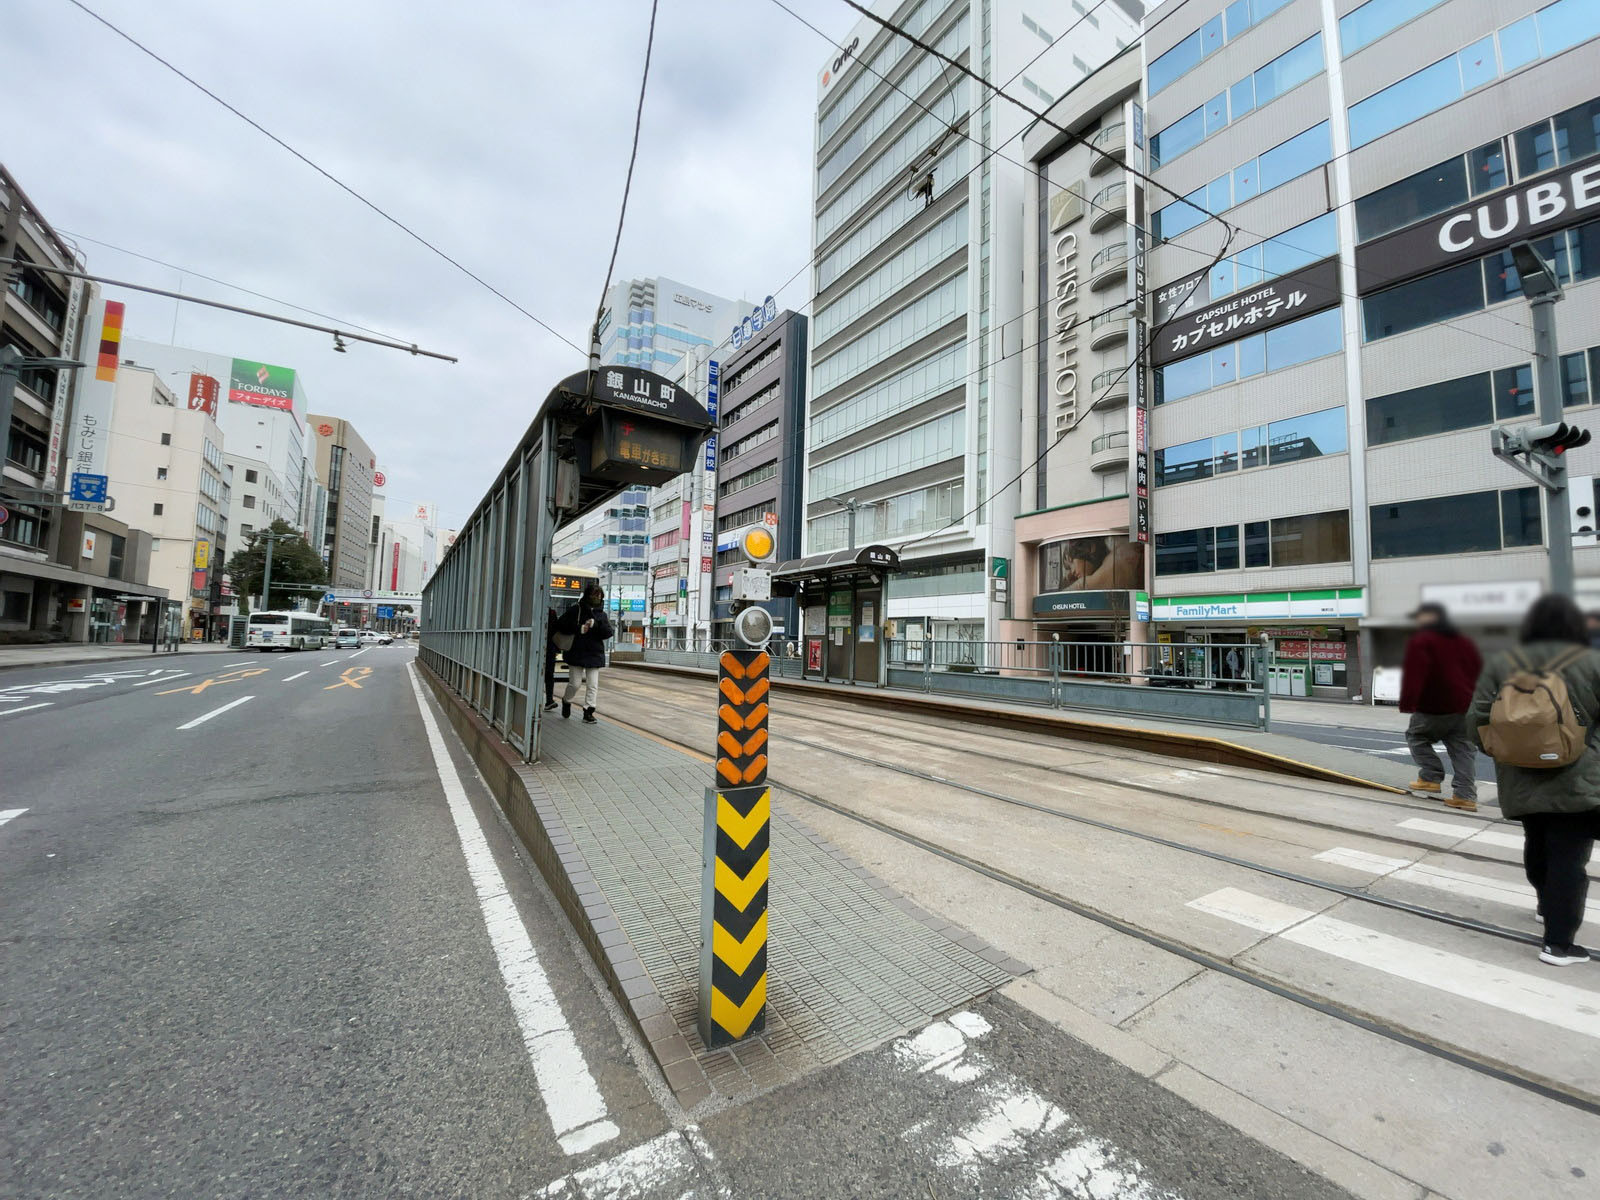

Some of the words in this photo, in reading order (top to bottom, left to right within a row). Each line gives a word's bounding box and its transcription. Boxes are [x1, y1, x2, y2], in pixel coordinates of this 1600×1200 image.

[1438, 164, 1600, 252] CUBE
[1055, 232, 1077, 343] CHISUN
[1136, 237, 1144, 304] CUBE
[1158, 275, 1203, 304] 女性フロア
[1195, 300, 1239, 324] CAPSULE
[1241, 287, 1276, 307] HOTEL
[1172, 290, 1308, 352] カプセルホテル
[235, 392, 287, 406] フォーデイズ
[238, 382, 288, 398] FORDAYS
[606, 370, 676, 403] 銀山町
[613, 391, 668, 409] KANAYAMACHO
[1055, 345, 1077, 441] HOTEL
[76, 414, 97, 474] もみじ銀行
[1137, 454, 1147, 485] 焼肉
[1176, 605, 1237, 618] FamilyMart
